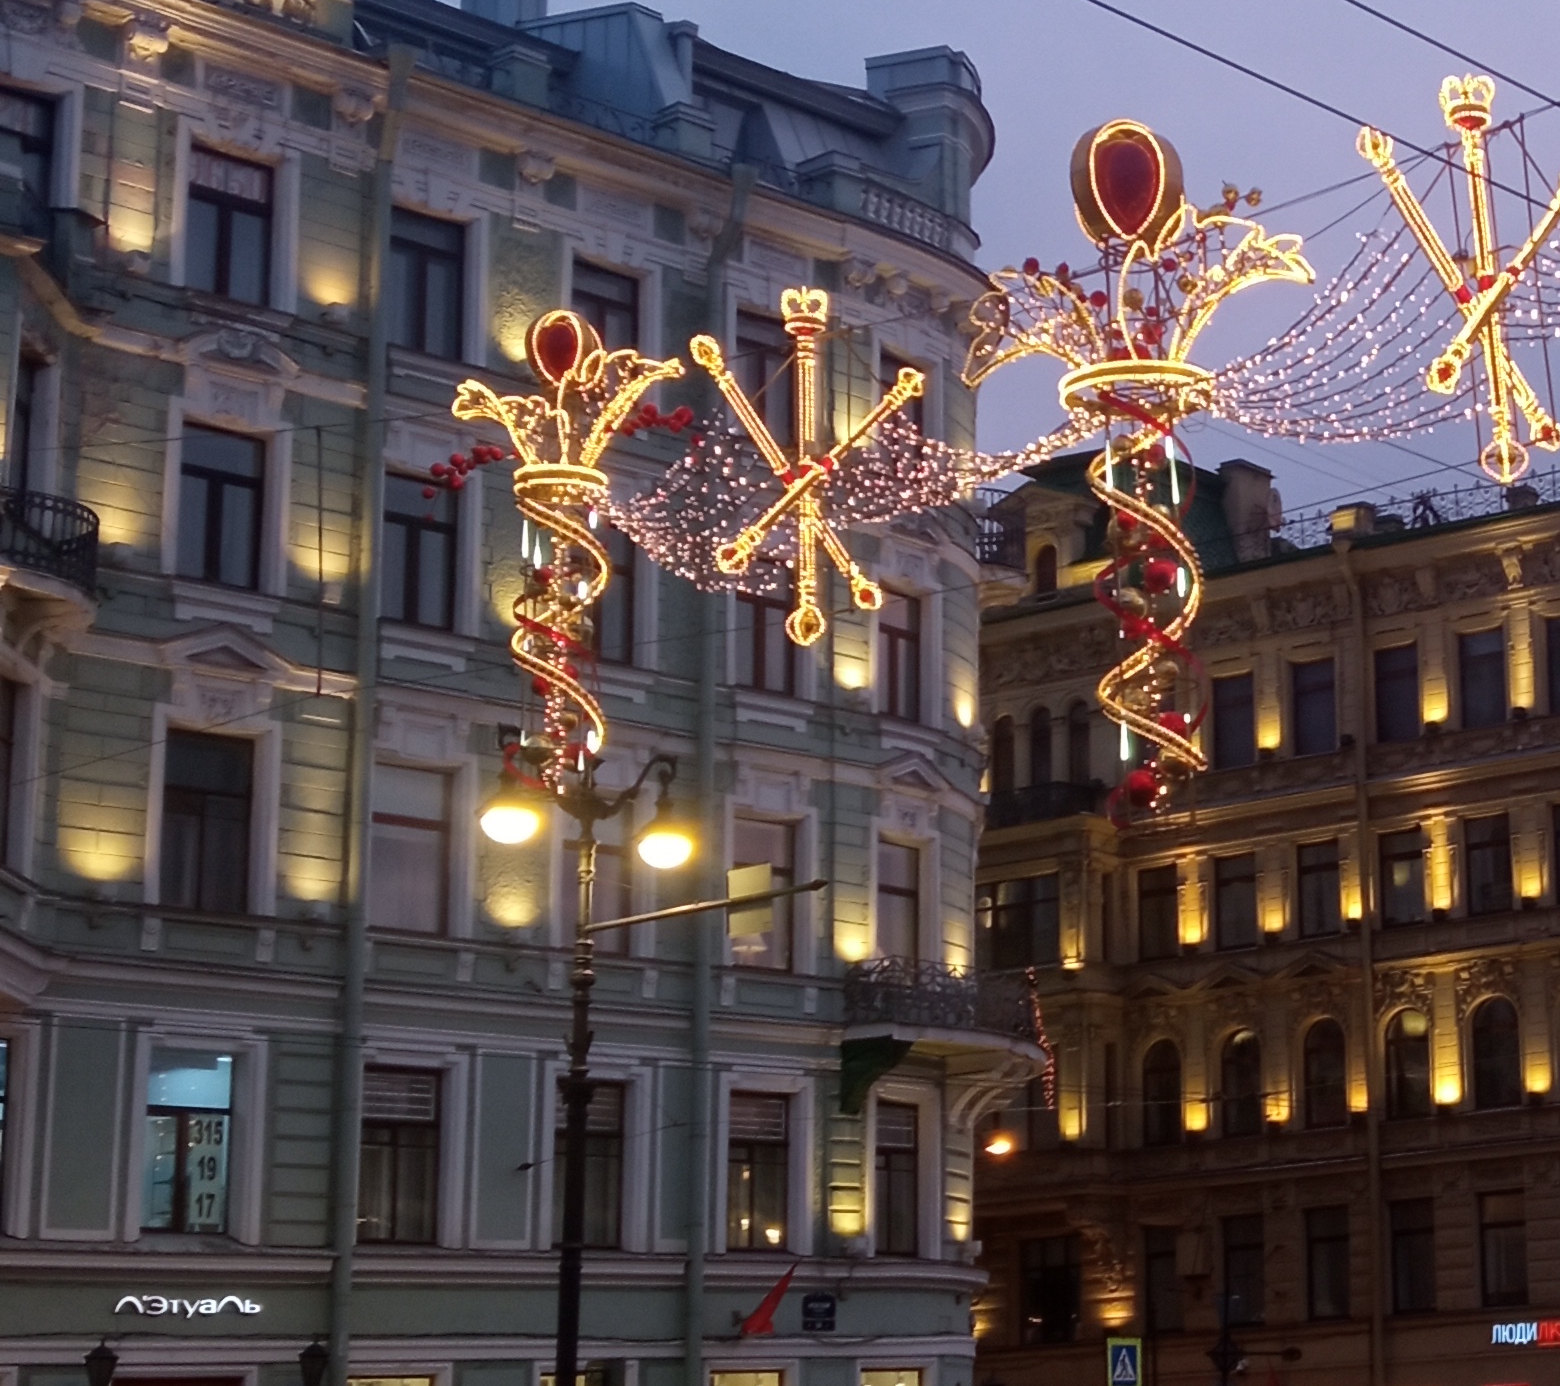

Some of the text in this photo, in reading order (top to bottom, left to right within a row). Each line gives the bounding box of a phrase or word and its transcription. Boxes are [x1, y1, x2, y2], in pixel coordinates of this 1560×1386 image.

[194, 1120, 224, 1146] 315
[197, 1156, 217, 1181] 19
[195, 1193, 215, 1219] 17
